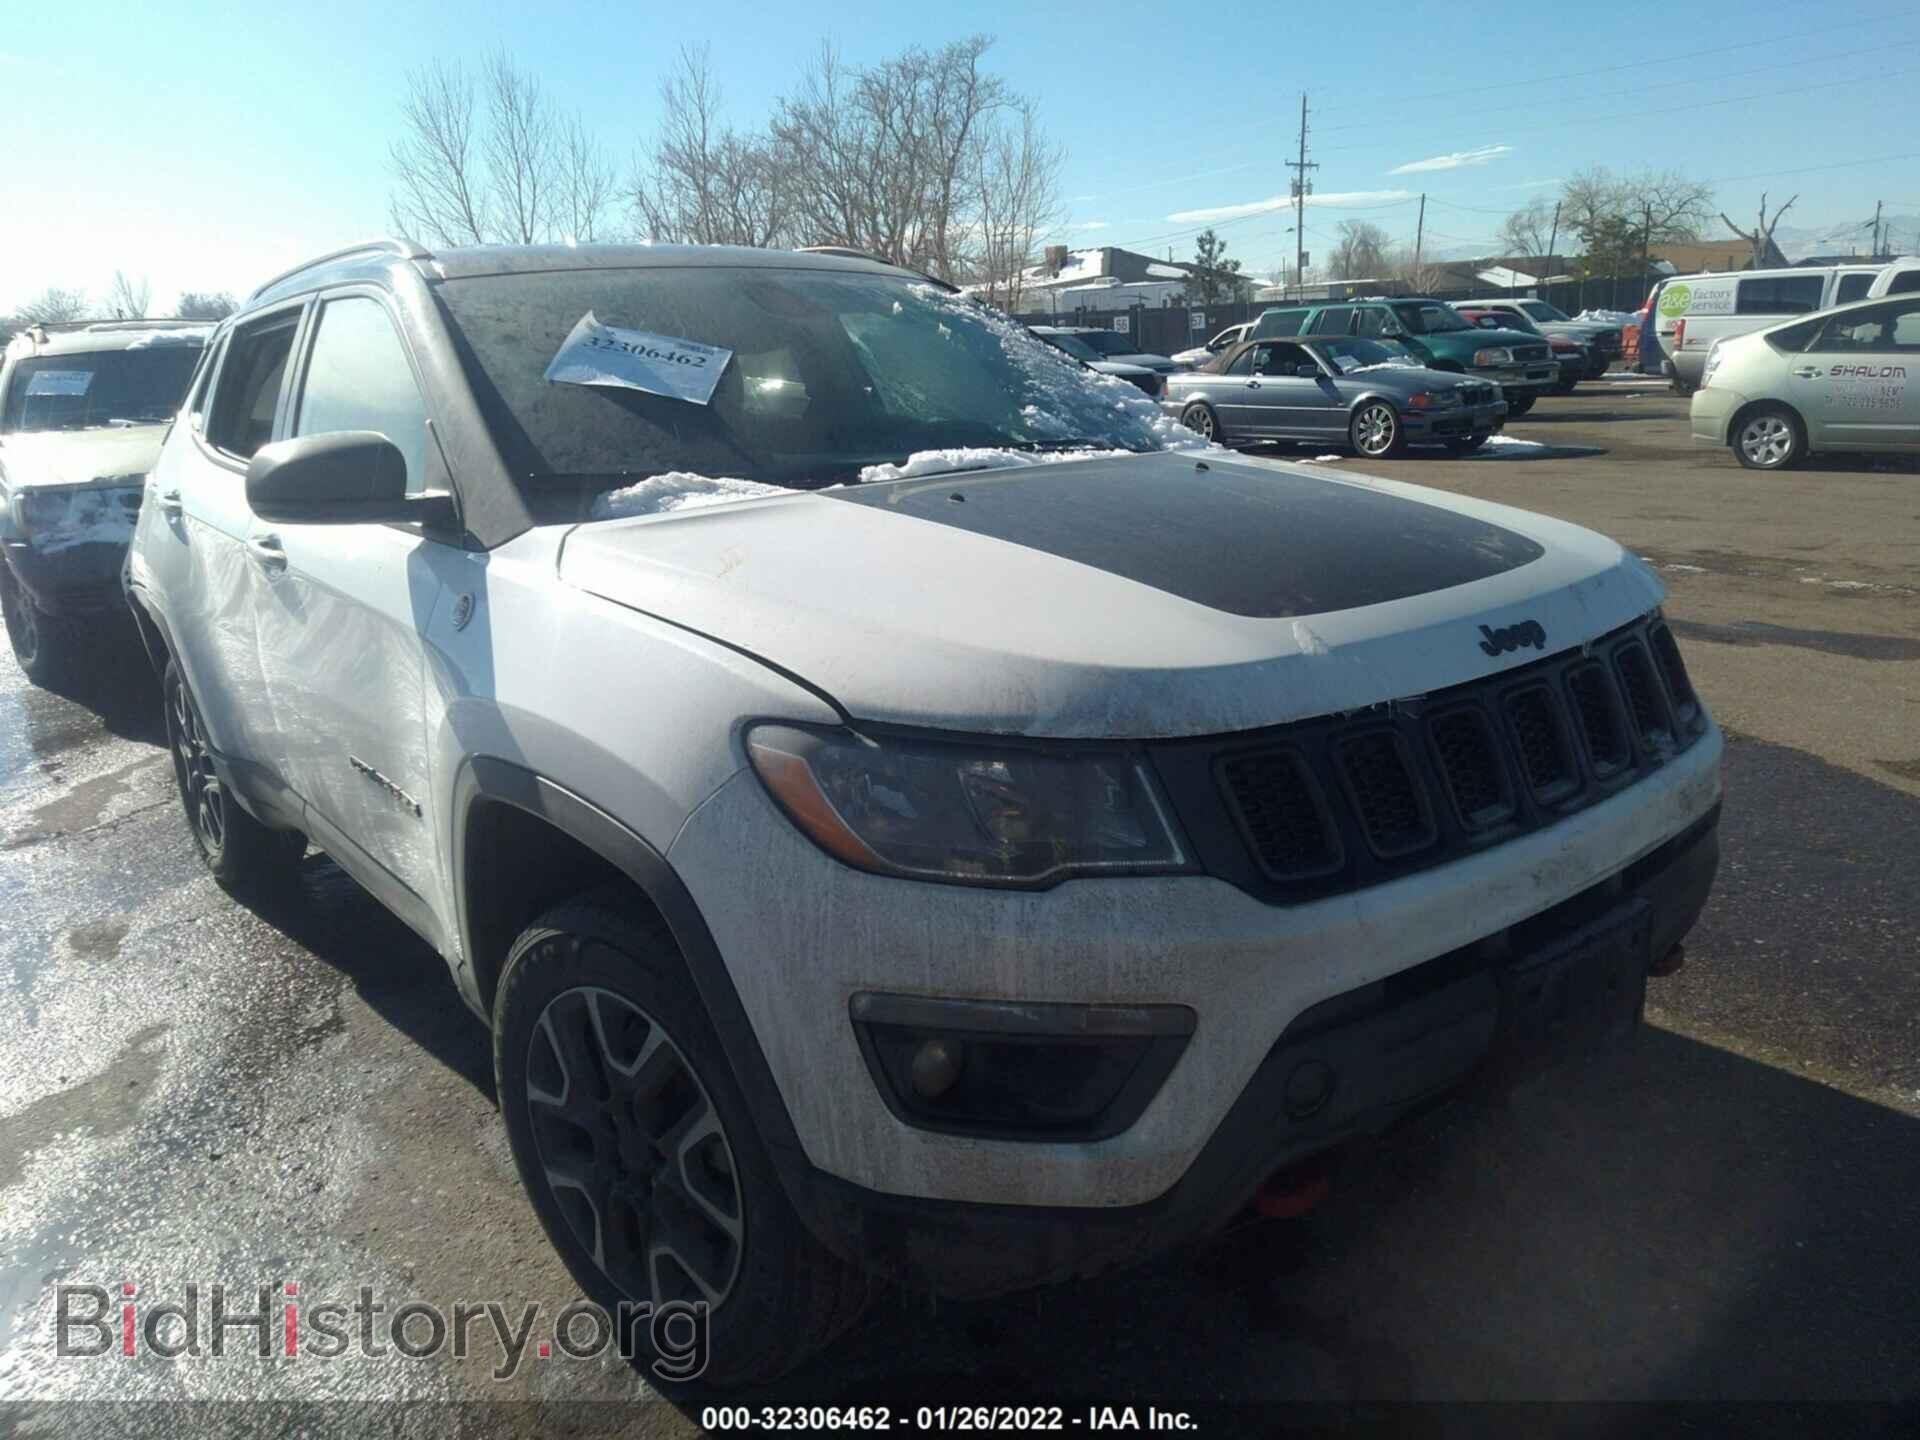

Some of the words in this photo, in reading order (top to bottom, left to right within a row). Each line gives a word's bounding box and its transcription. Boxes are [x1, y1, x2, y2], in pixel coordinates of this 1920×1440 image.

[1693, 287, 1732, 301] factory
[1691, 301, 1731, 311] service
[583, 336, 707, 369] 32306462
[1829, 365, 1907, 379] SHALOM
[1478, 619, 1547, 657] Jeep
